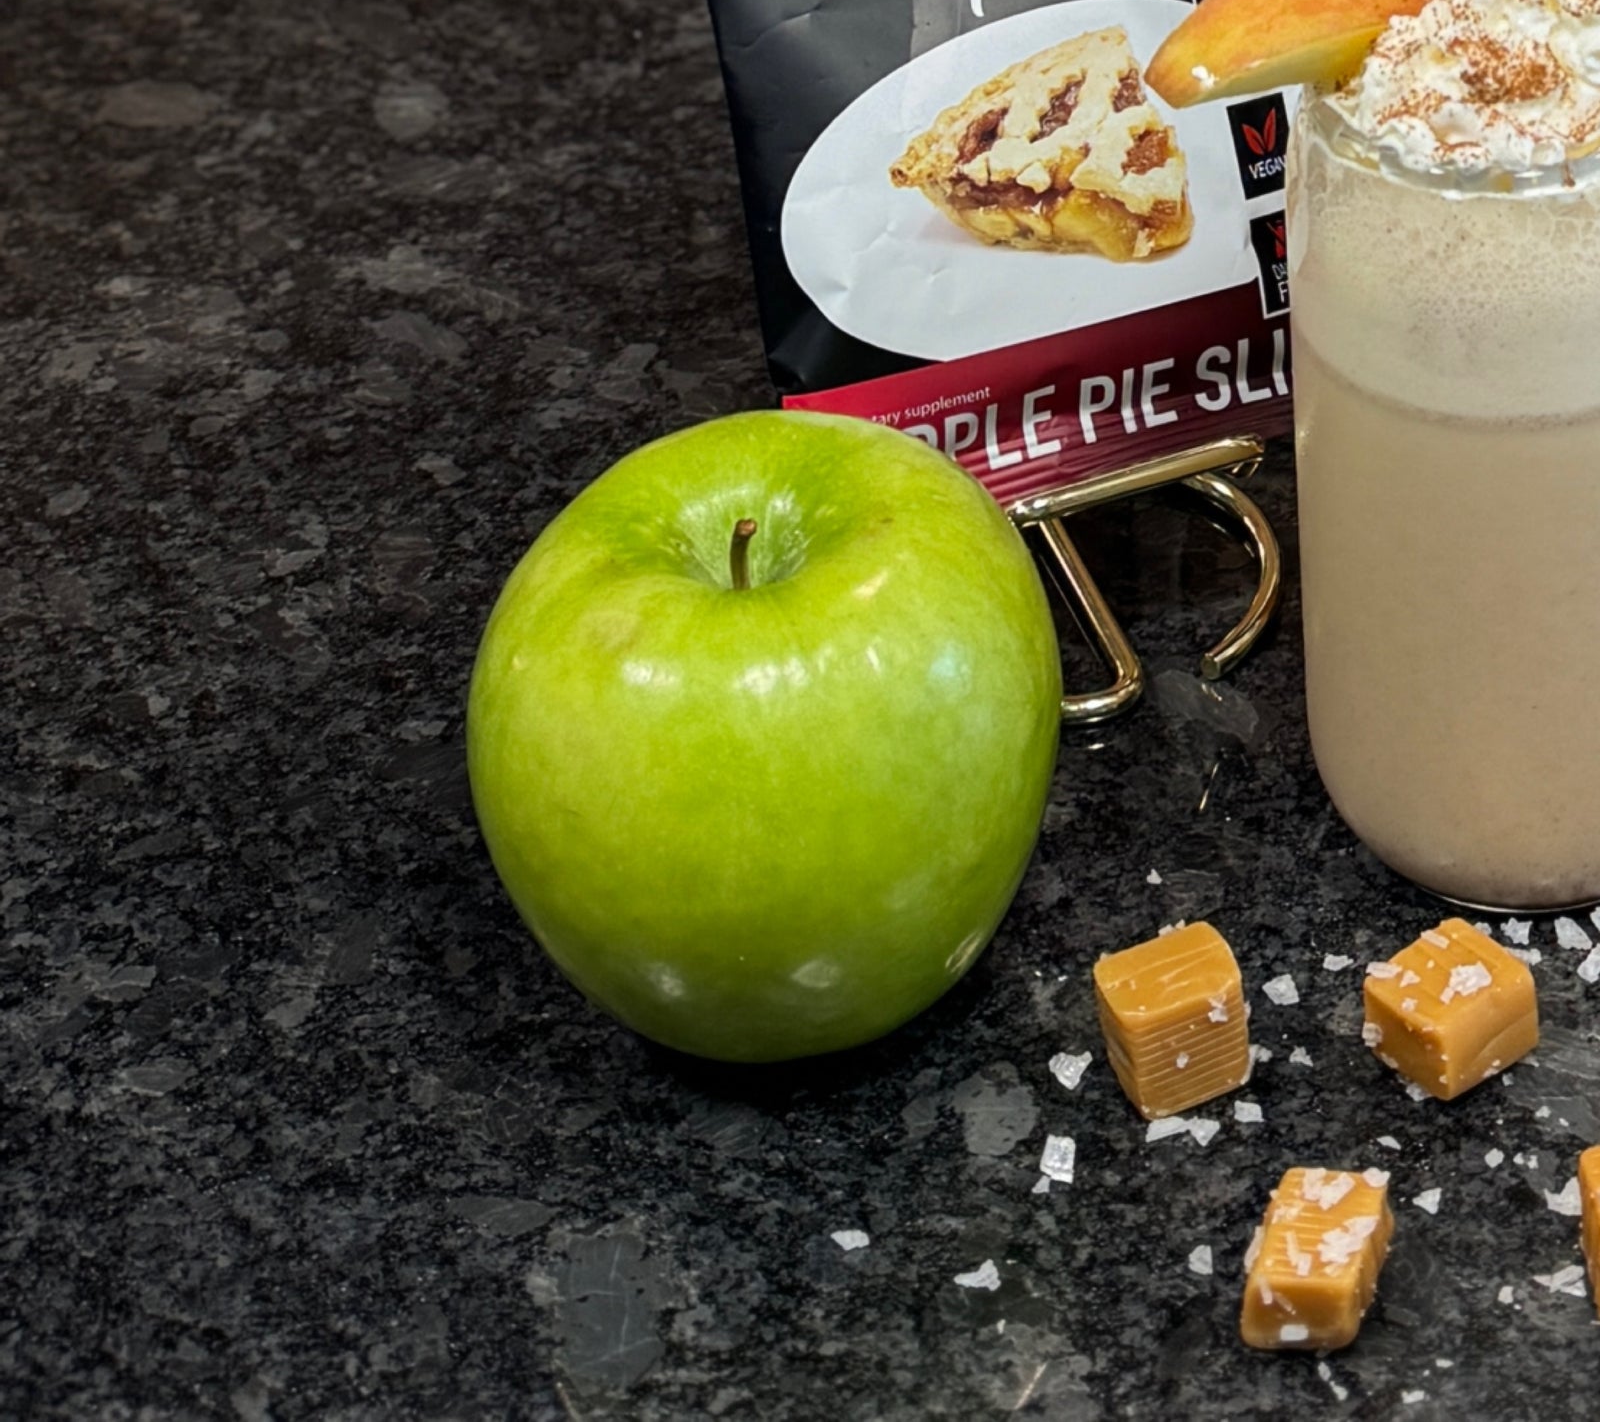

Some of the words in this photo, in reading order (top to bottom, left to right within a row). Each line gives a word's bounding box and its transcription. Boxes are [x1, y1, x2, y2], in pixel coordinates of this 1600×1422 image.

[902, 384, 1063, 471] PLE
[1078, 358, 1179, 444] PIE
[1194, 328, 1290, 412] SLI
[904, 386, 991, 420] supplement
